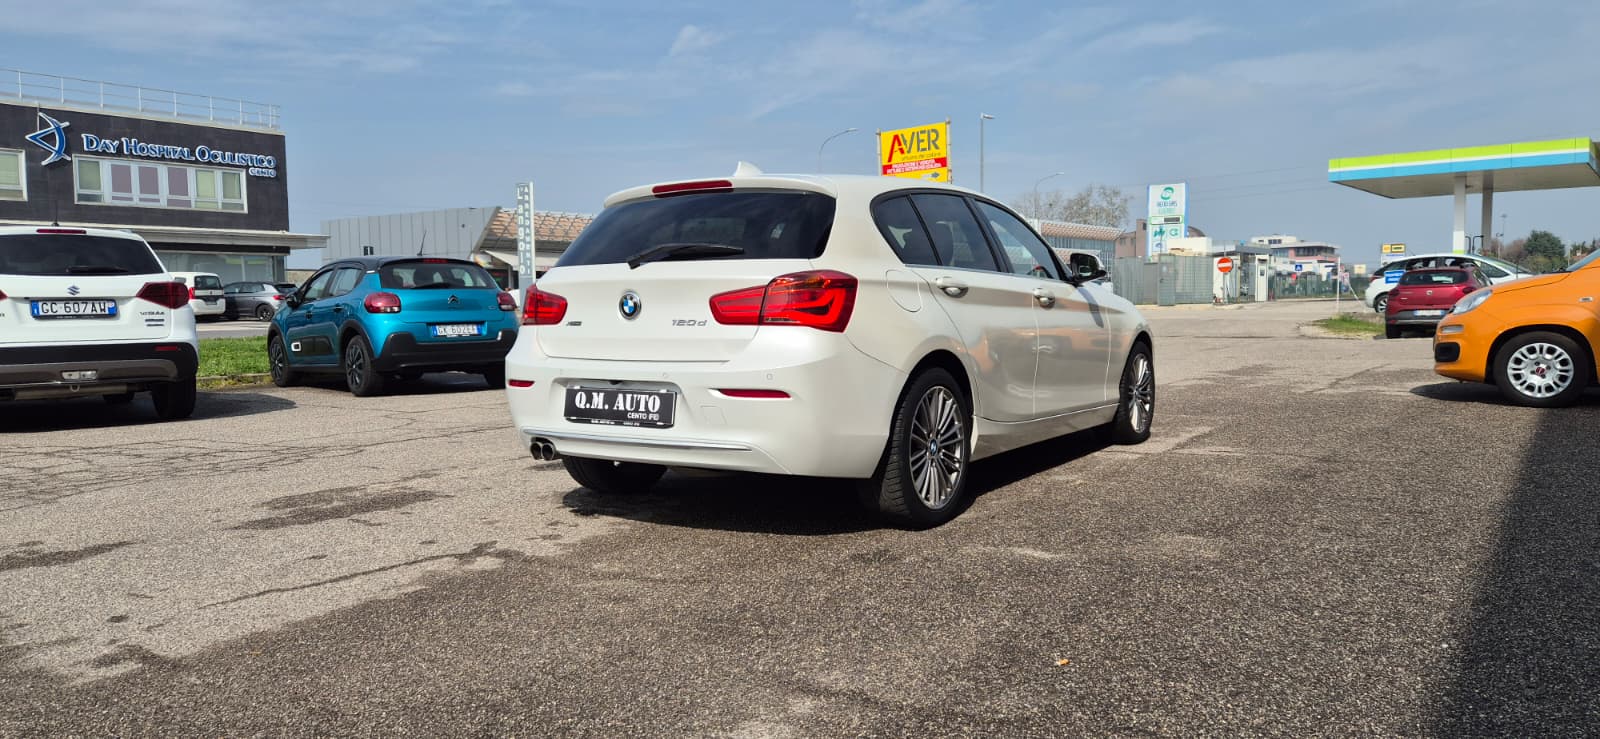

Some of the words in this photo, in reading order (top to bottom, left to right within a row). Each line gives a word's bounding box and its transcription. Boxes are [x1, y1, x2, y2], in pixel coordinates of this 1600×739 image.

[121, 137, 195, 161] HOSPITAL
[195, 145, 277, 169] OCULISTICO
[887, 128, 940, 163] AVER
[41, 302, 59, 314] GC
[575, 391, 609, 410] Q.M.
[613, 393, 660, 412] AUTO
[627, 412, 647, 420] CENTO
